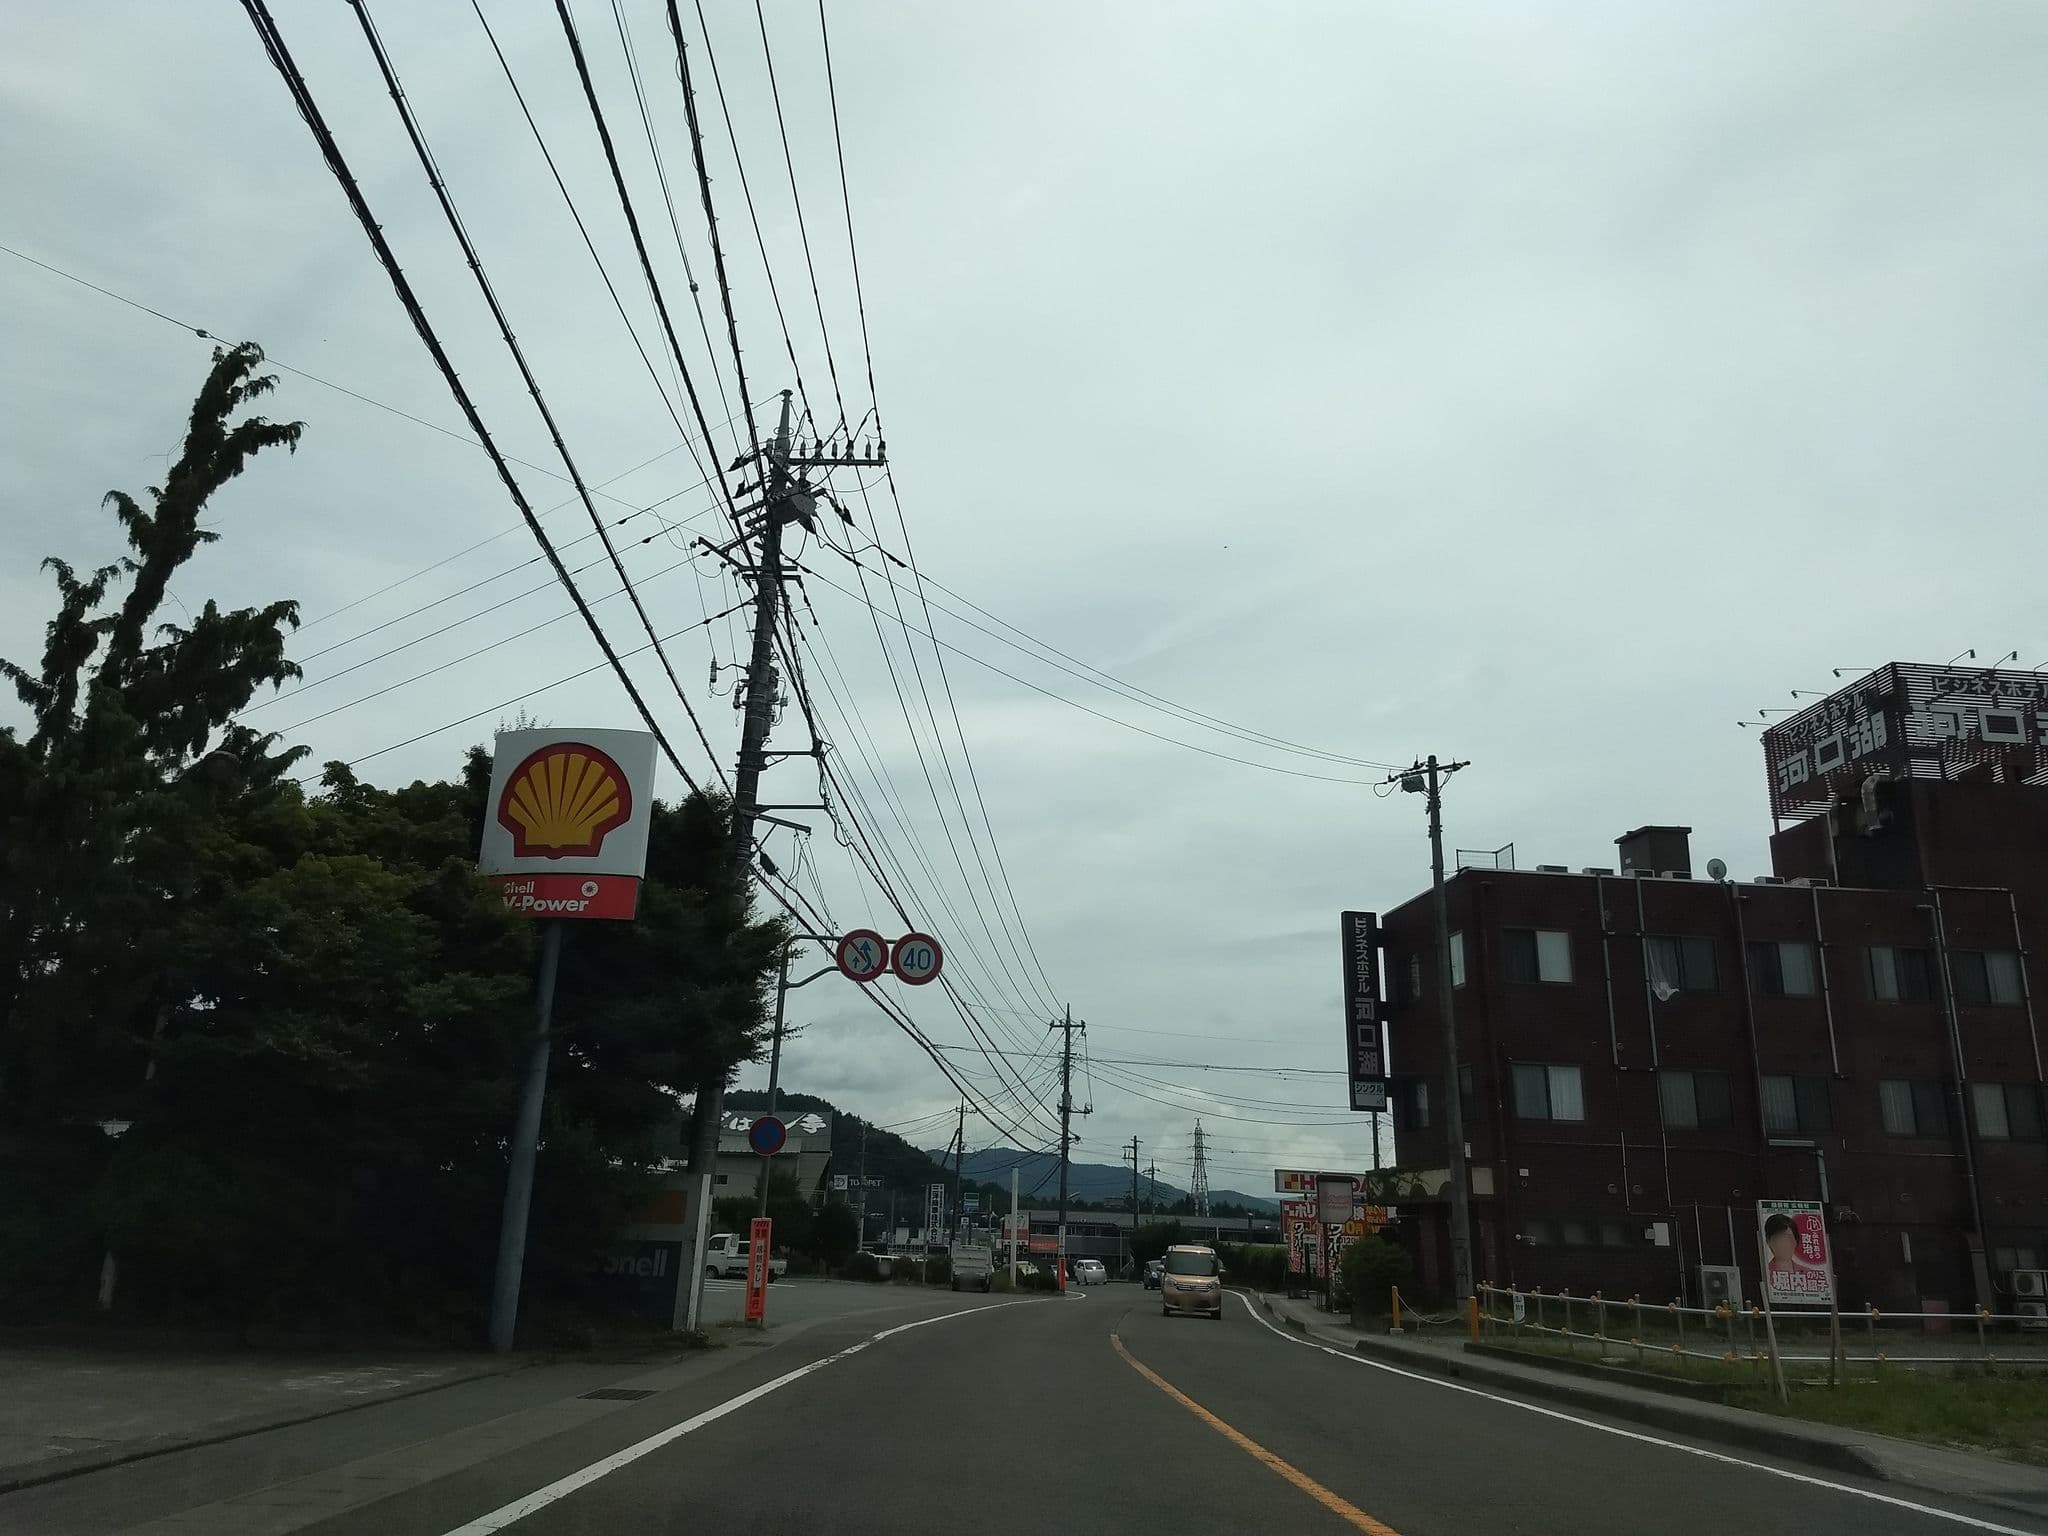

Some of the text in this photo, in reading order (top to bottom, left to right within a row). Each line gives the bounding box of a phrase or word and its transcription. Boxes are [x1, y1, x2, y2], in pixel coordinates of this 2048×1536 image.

[1788, 691, 1866, 743] ビジネスホテル
[1777, 710, 1888, 794] 河口湖
[502, 895, 590, 913] V-Power
[504, 881, 535, 895] Shell
[903, 947, 931, 971] 40
[1354, 916, 1371, 993] ビジネスホテル
